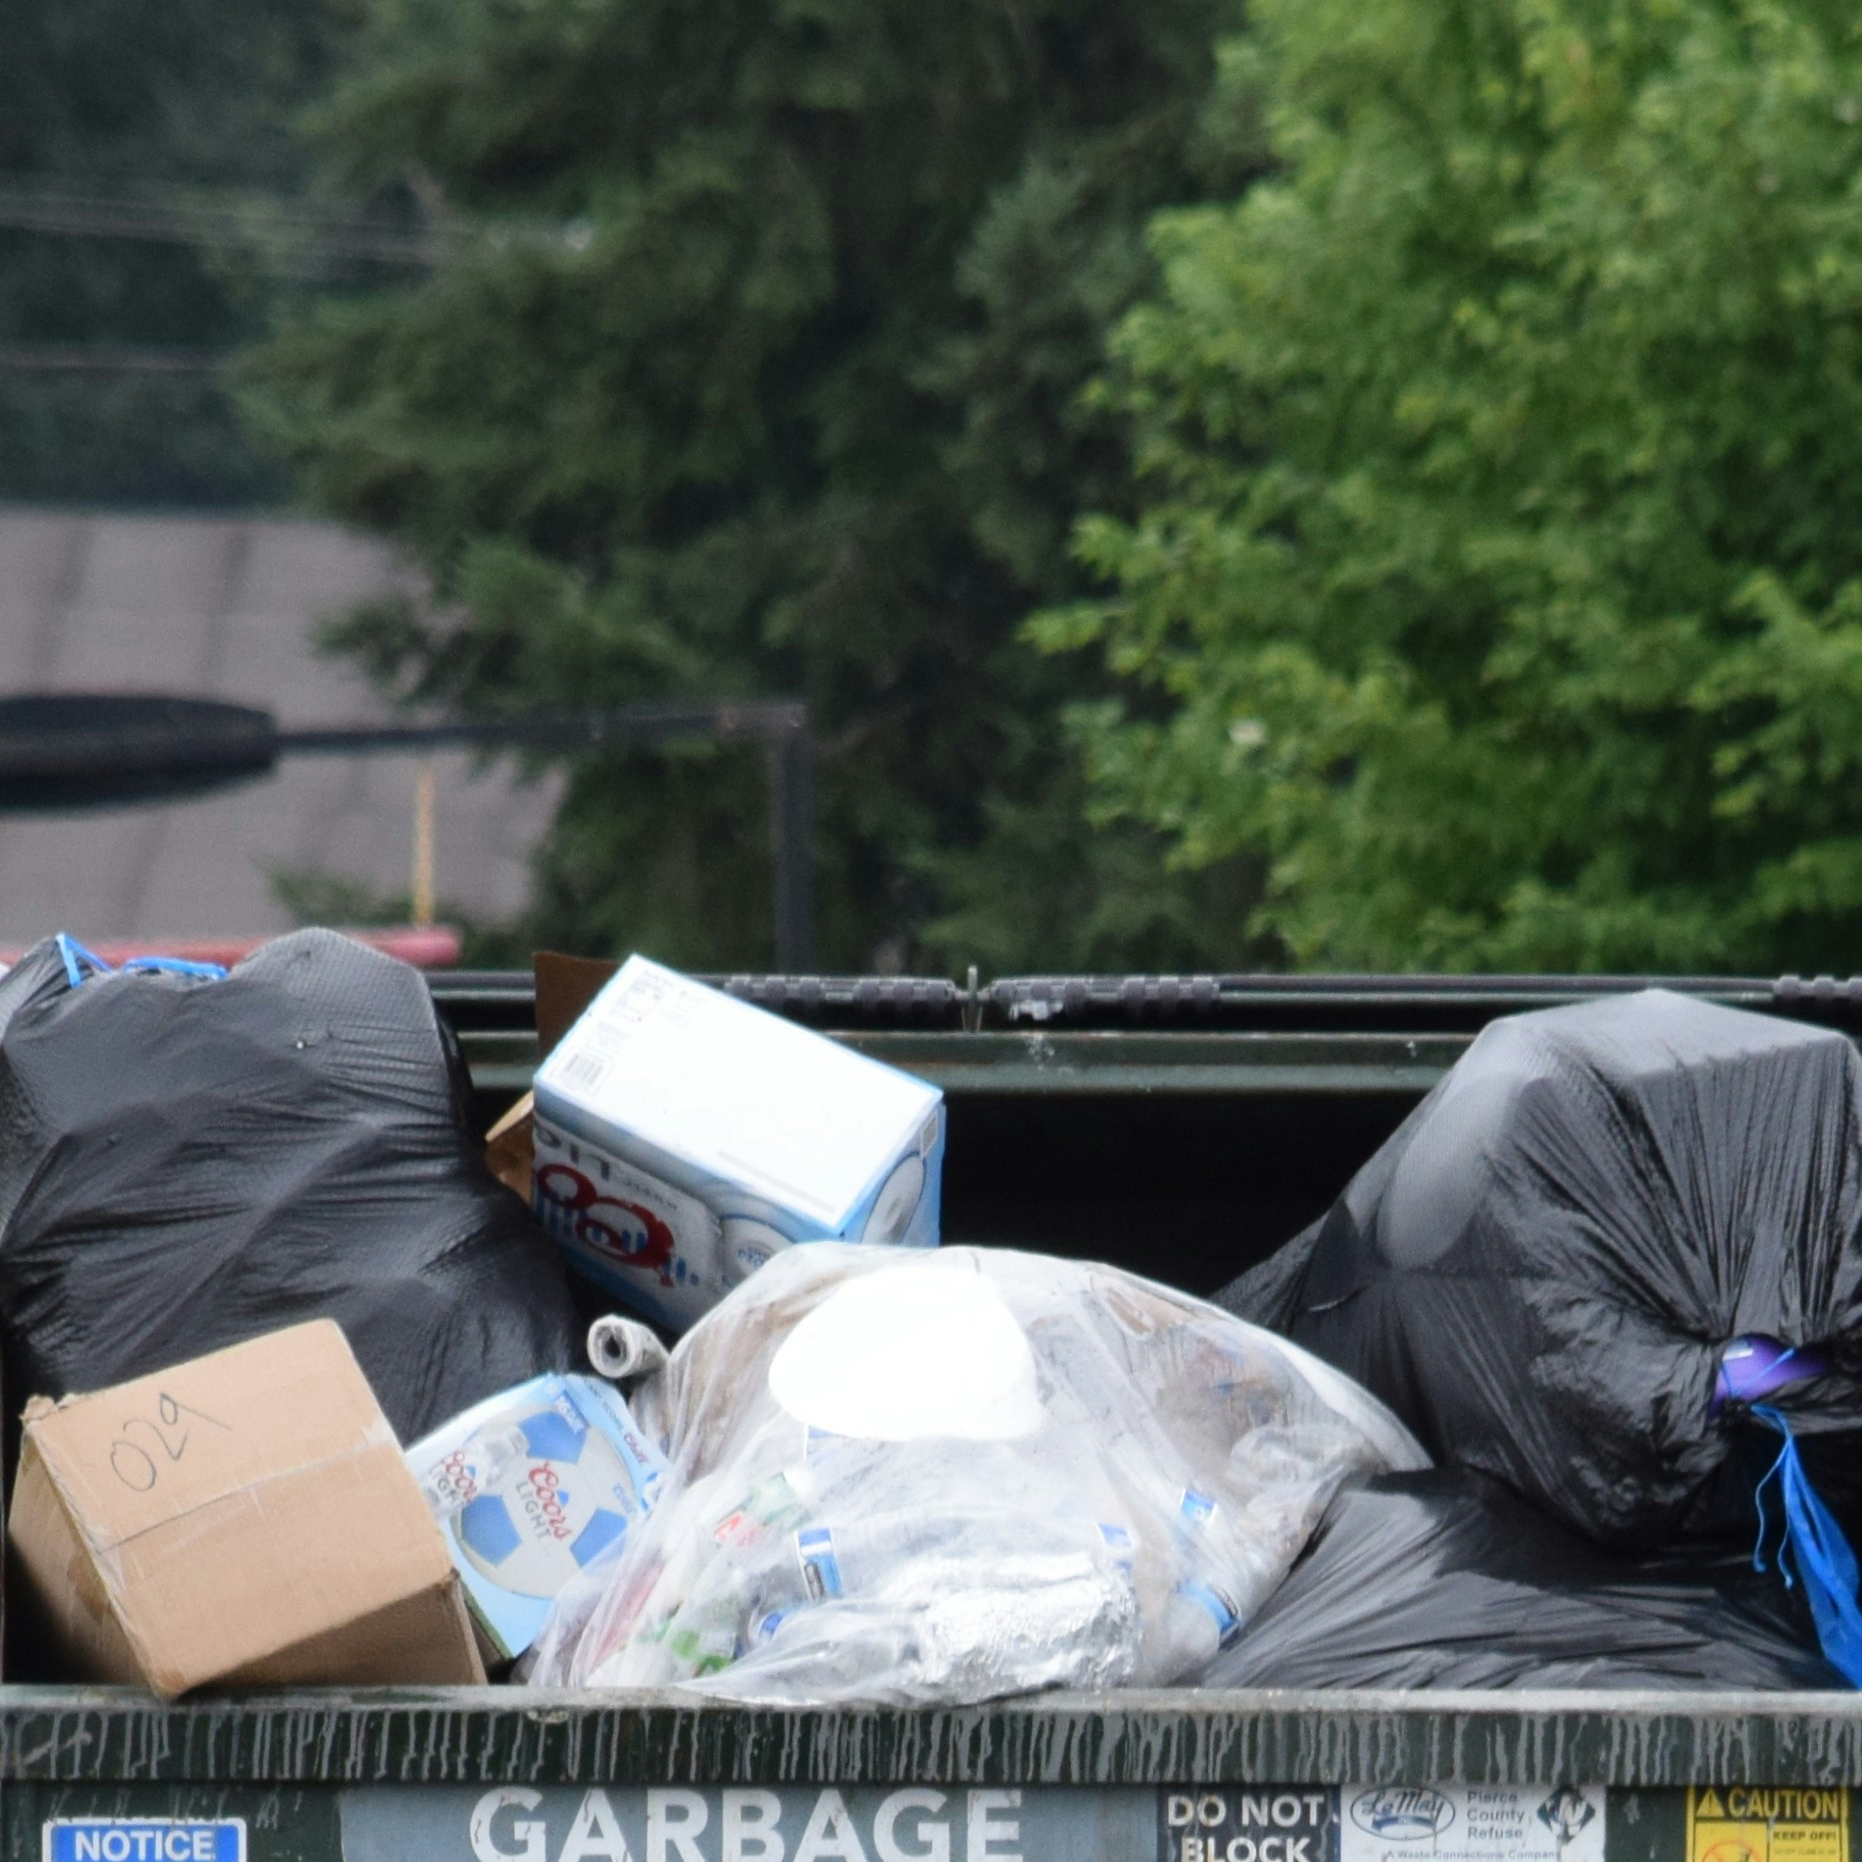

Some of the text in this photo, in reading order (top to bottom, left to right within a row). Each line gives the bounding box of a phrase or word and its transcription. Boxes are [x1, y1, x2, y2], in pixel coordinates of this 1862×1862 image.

[515, 1481, 553, 1540] LIGHT
[528, 1461, 573, 1541] Coors
[1167, 1795, 1325, 1828] DO NOT
[1467, 1790, 1518, 1804] Pierce
[1728, 1787, 1838, 1819] CAUTION
[1467, 1808, 1525, 1824] County
[74, 1830, 216, 1862] NOTICE
[1467, 1826, 1523, 1840] Refuse
[1773, 1831, 1806, 1841] KEEP
